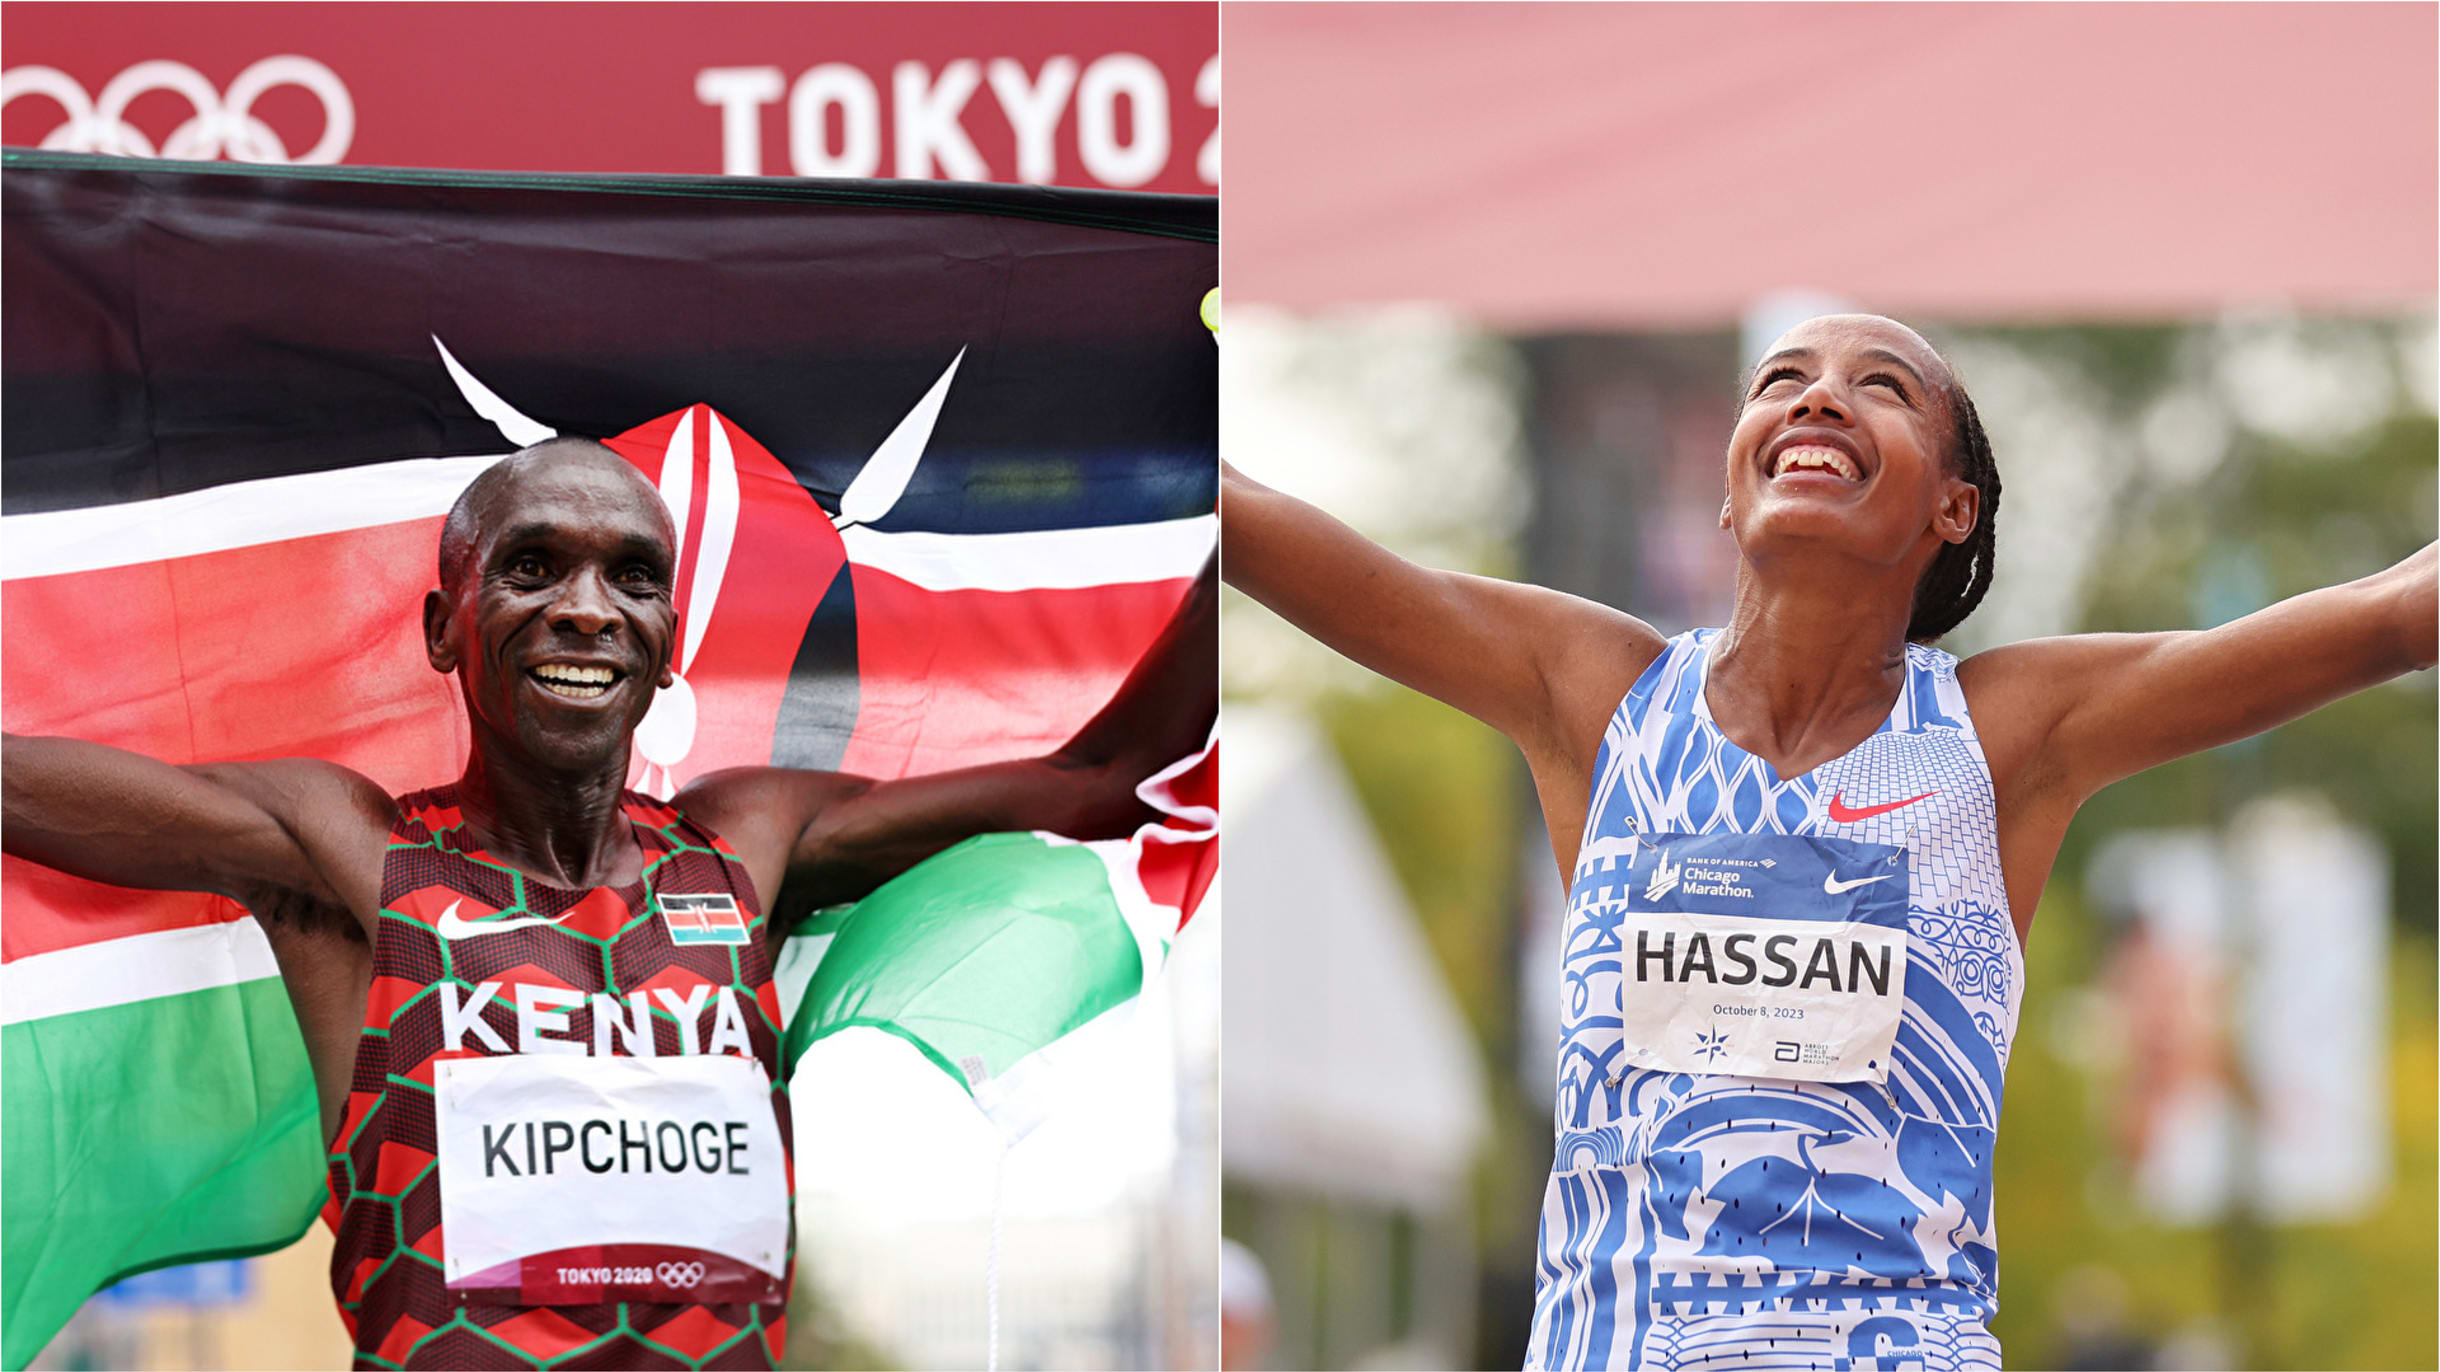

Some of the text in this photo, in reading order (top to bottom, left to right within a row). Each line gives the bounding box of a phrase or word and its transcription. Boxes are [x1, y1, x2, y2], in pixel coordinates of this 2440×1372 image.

[695, 53, 1171, 188] TOKYO
[1684, 867, 1741, 885] Chicago
[1687, 857, 1709, 865] BANK
[1722, 859, 1759, 868] AMERICA
[1636, 930, 1892, 997] HASSAN
[439, 982, 754, 1057] KENYA
[1713, 1003, 1804, 1020] October 8, 2023
[482, 1119, 750, 1177] KIPCHOGE
[557, 1267, 654, 1285] TOKYO 2020
